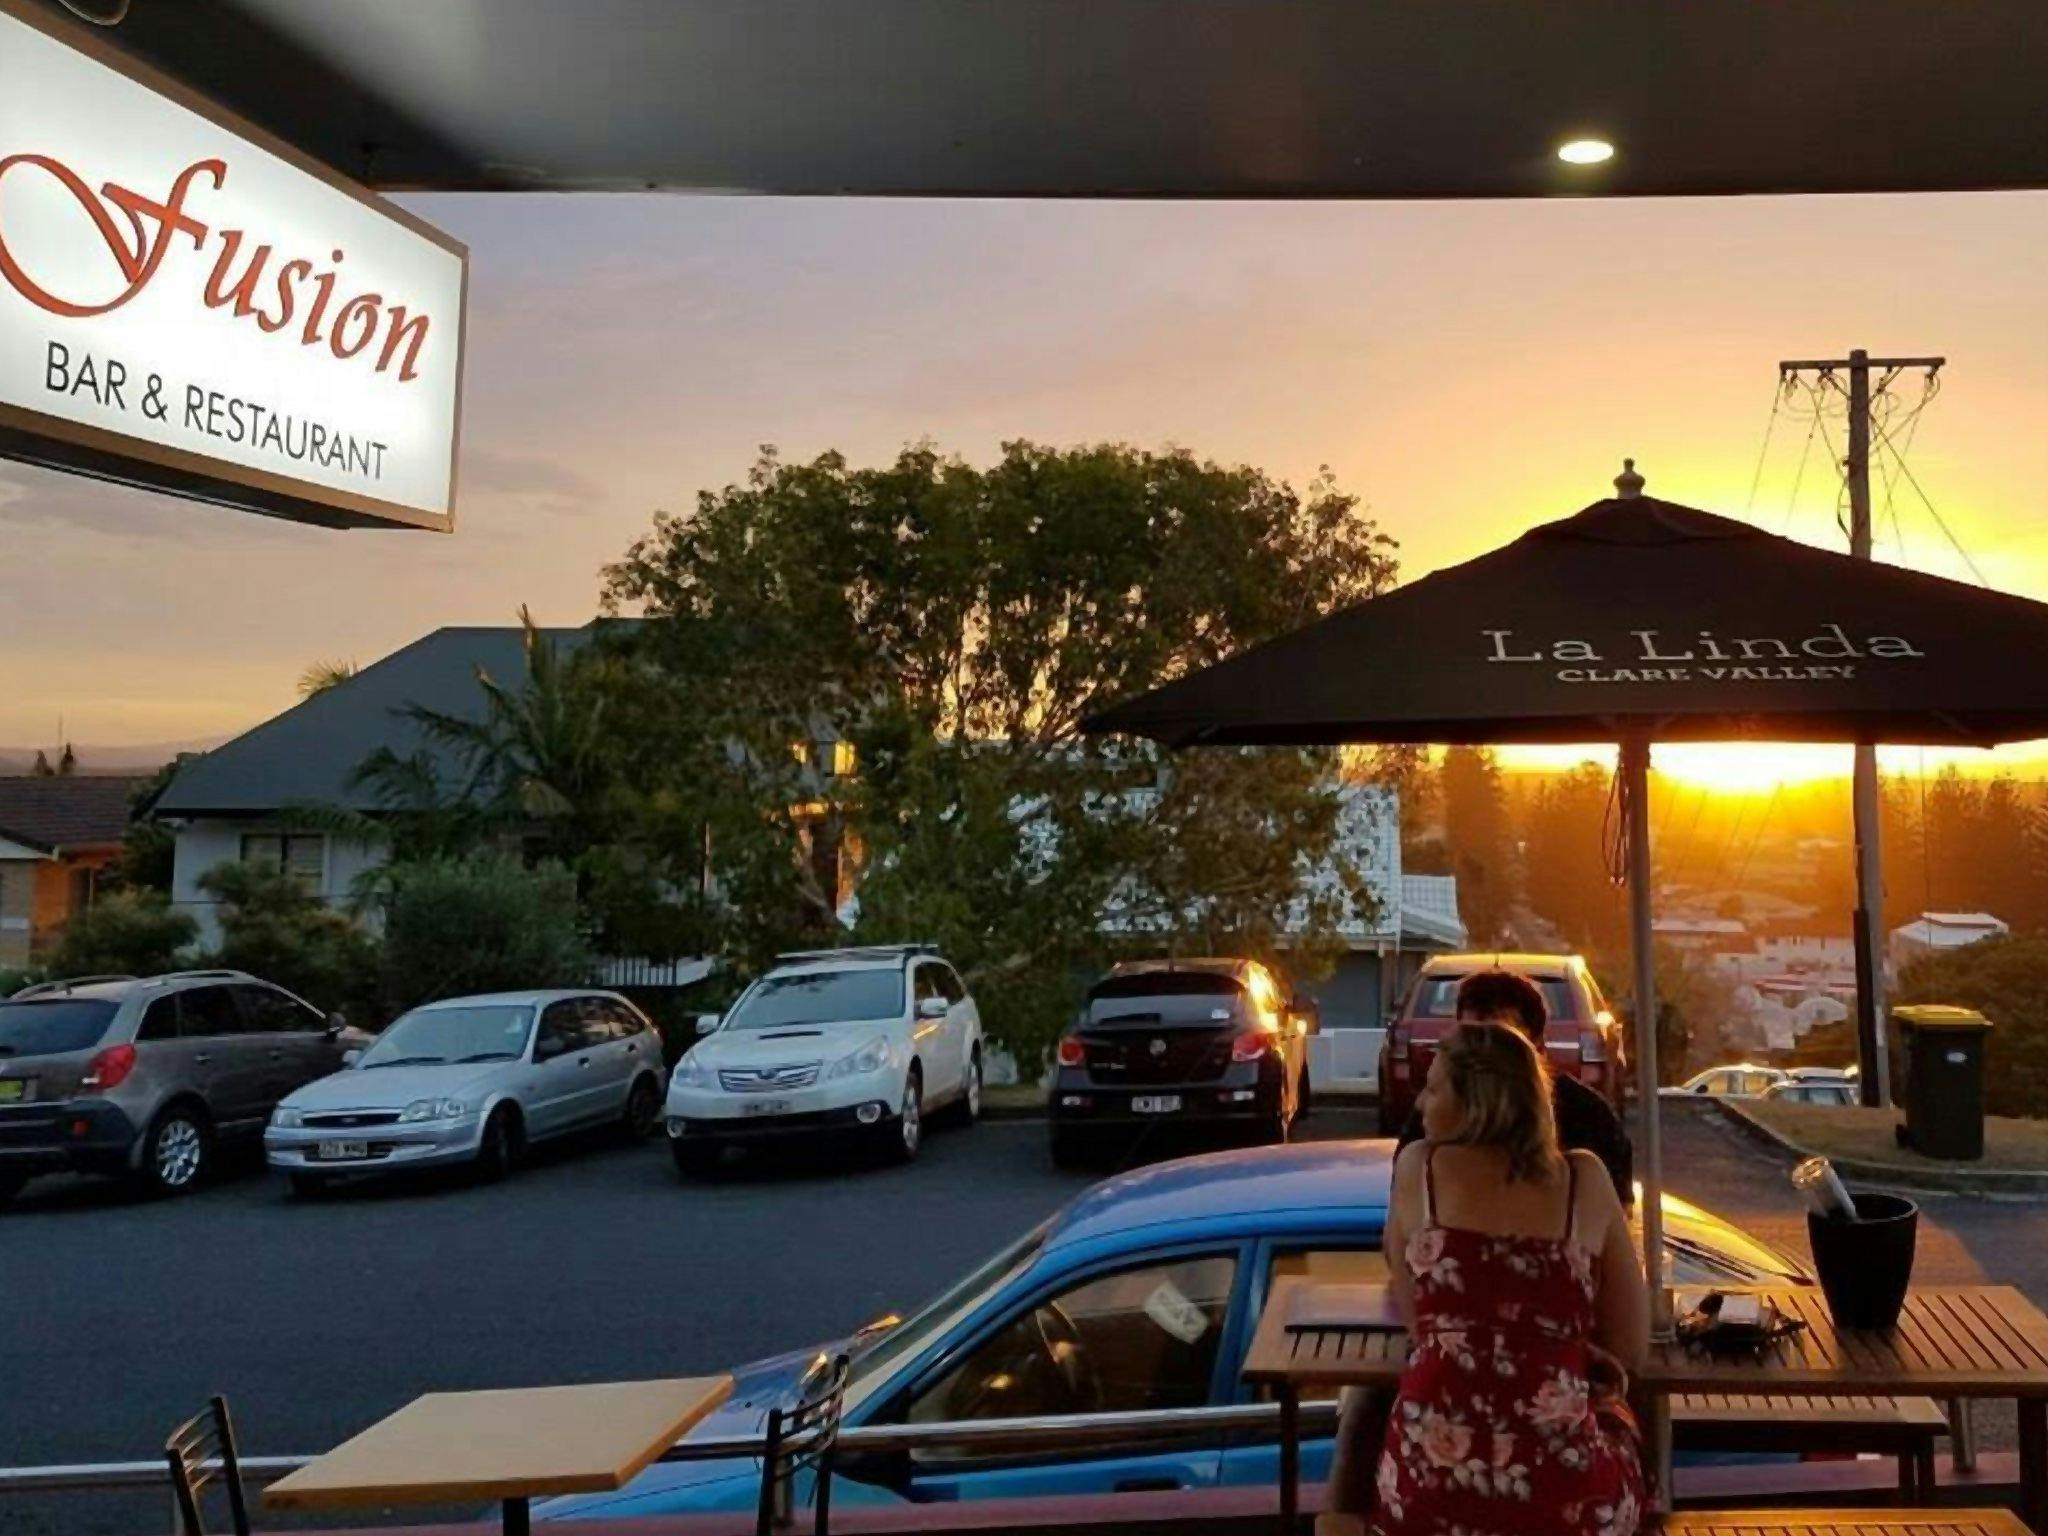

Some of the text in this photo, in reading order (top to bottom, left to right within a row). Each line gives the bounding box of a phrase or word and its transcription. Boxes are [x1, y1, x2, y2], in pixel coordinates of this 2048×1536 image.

[0, 153, 430, 382] Fusion
[45, 340, 389, 482] BAR & RESTAURANT
[1482, 623, 1925, 662] La Linda
[1556, 665, 1856, 682] CLARE VALLEY
